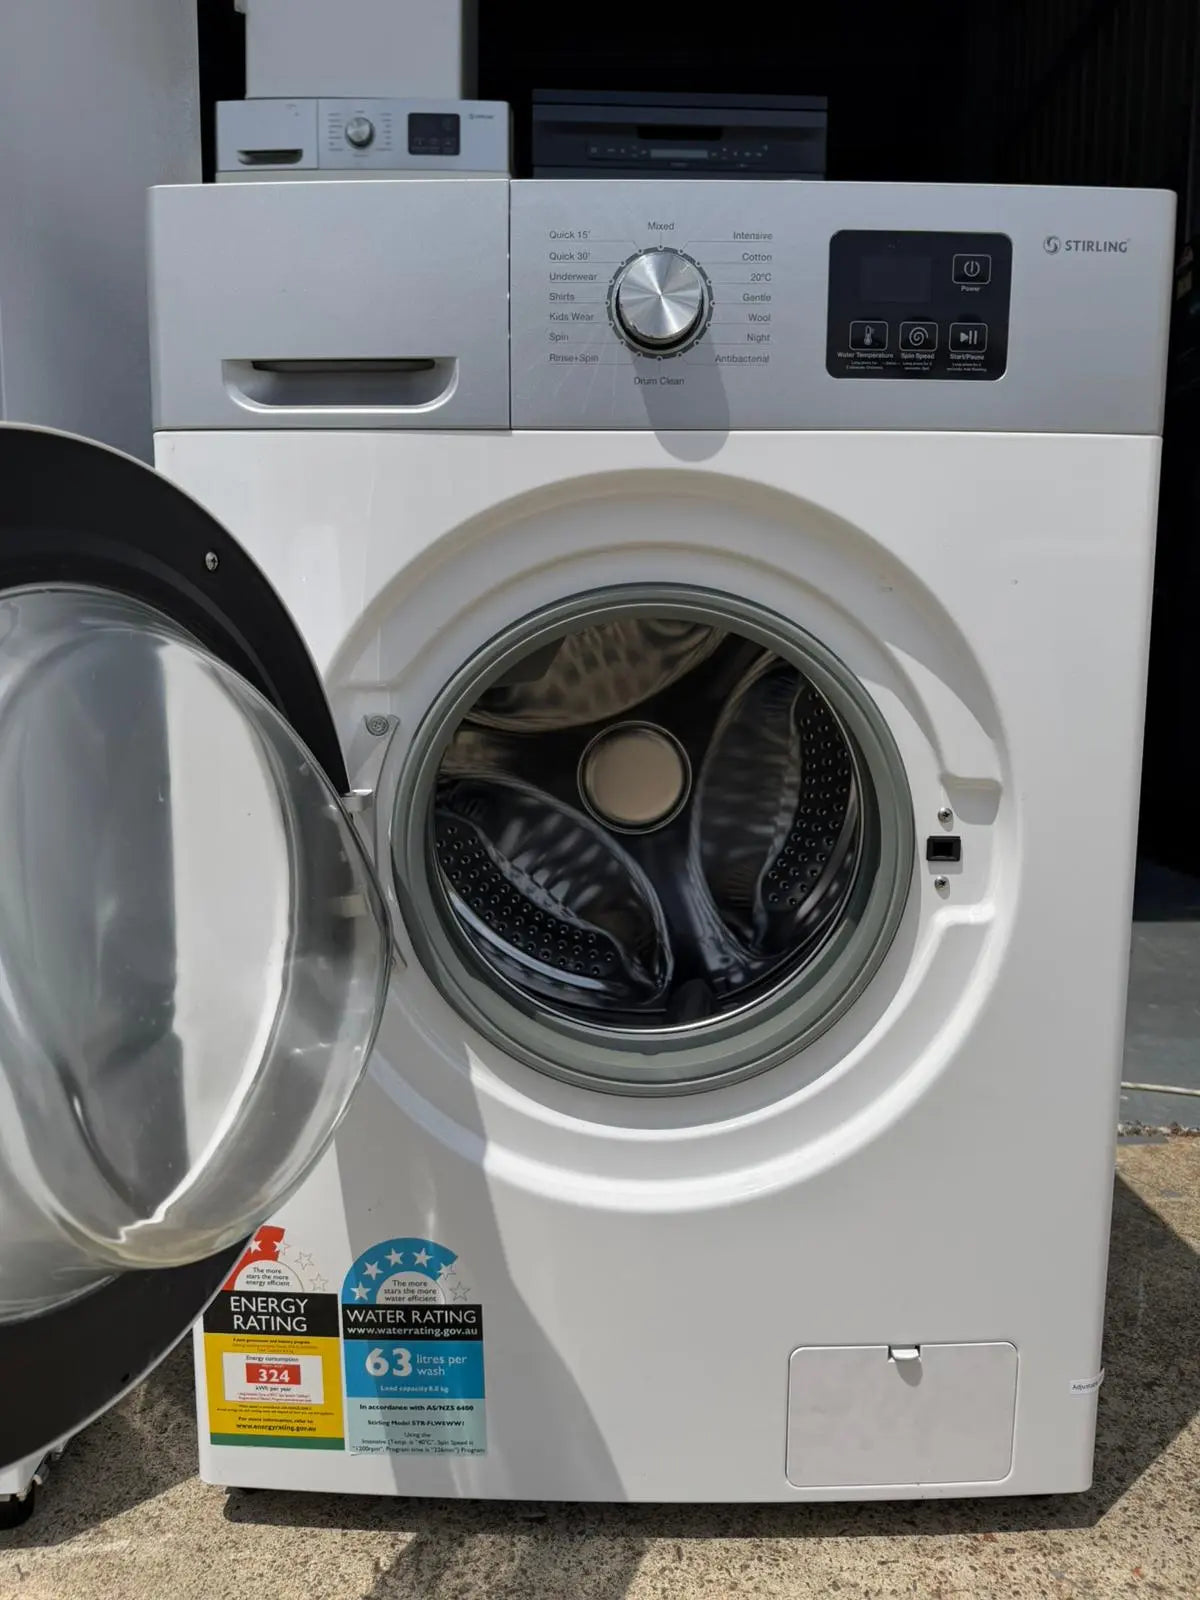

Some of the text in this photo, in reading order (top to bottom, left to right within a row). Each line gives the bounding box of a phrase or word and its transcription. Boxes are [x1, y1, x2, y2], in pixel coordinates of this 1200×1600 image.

[648, 222, 675, 230] Mixed
[549, 231, 575, 240] Quick
[733, 232, 773, 240] Intensive
[1065, 240, 1128, 253] STIRLING
[549, 252, 575, 261] Quick
[742, 253, 772, 261] Cotton
[549, 273, 598, 281] Underwear
[750, 273, 771, 282] 20°C
[549, 292, 575, 301] Shirts
[742, 293, 771, 301] Gentle
[549, 313, 594, 321] Kids Wear
[748, 313, 770, 322] Wool
[549, 333, 569, 342] Spin
[747, 334, 770, 343] Night
[549, 354, 599, 363] Rinse+Spin
[715, 354, 769, 363] Antibacterial
[634, 377, 684, 385] Drum Clean
[230, 1296, 308, 1314] ENERGY
[346, 1310, 476, 1324] WATER RATING
[233, 1315, 308, 1332] RATING
[347, 1327, 478, 1337] www.waterrating.gov.au
[365, 1348, 412, 1376] 63
[416, 1354, 467, 1366] litres per
[258, 1369, 290, 1382] 324
[416, 1367, 445, 1376] wash
[236, 1424, 316, 1432] www.energyrating.gov.au
